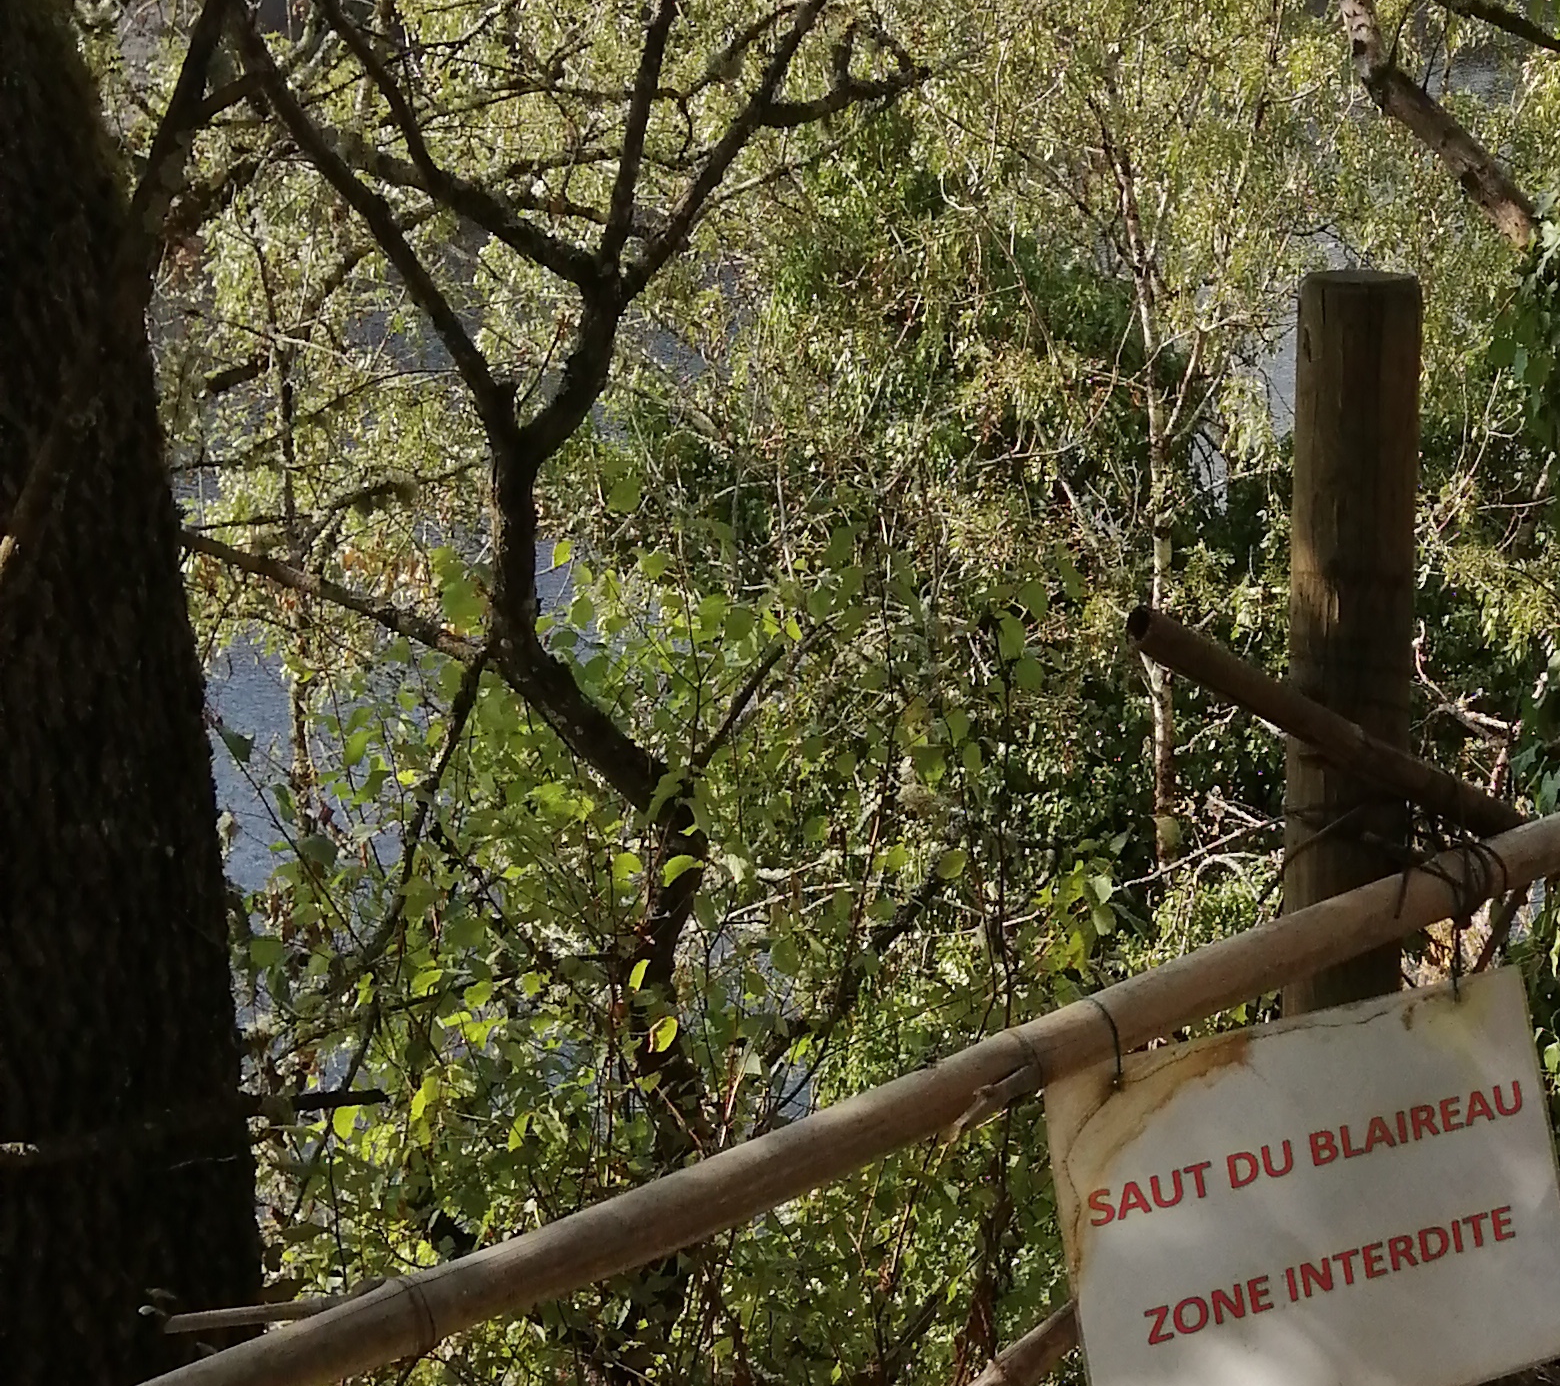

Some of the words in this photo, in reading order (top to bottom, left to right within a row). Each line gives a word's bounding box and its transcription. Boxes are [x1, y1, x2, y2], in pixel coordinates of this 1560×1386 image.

[1087, 1161, 1212, 1227] SAUT
[1226, 1139, 1294, 1189] DU
[1308, 1080, 1523, 1167] BLAIREAU
[1143, 1275, 1274, 1345] ZONE
[1285, 1206, 1516, 1302] INTERDITE
